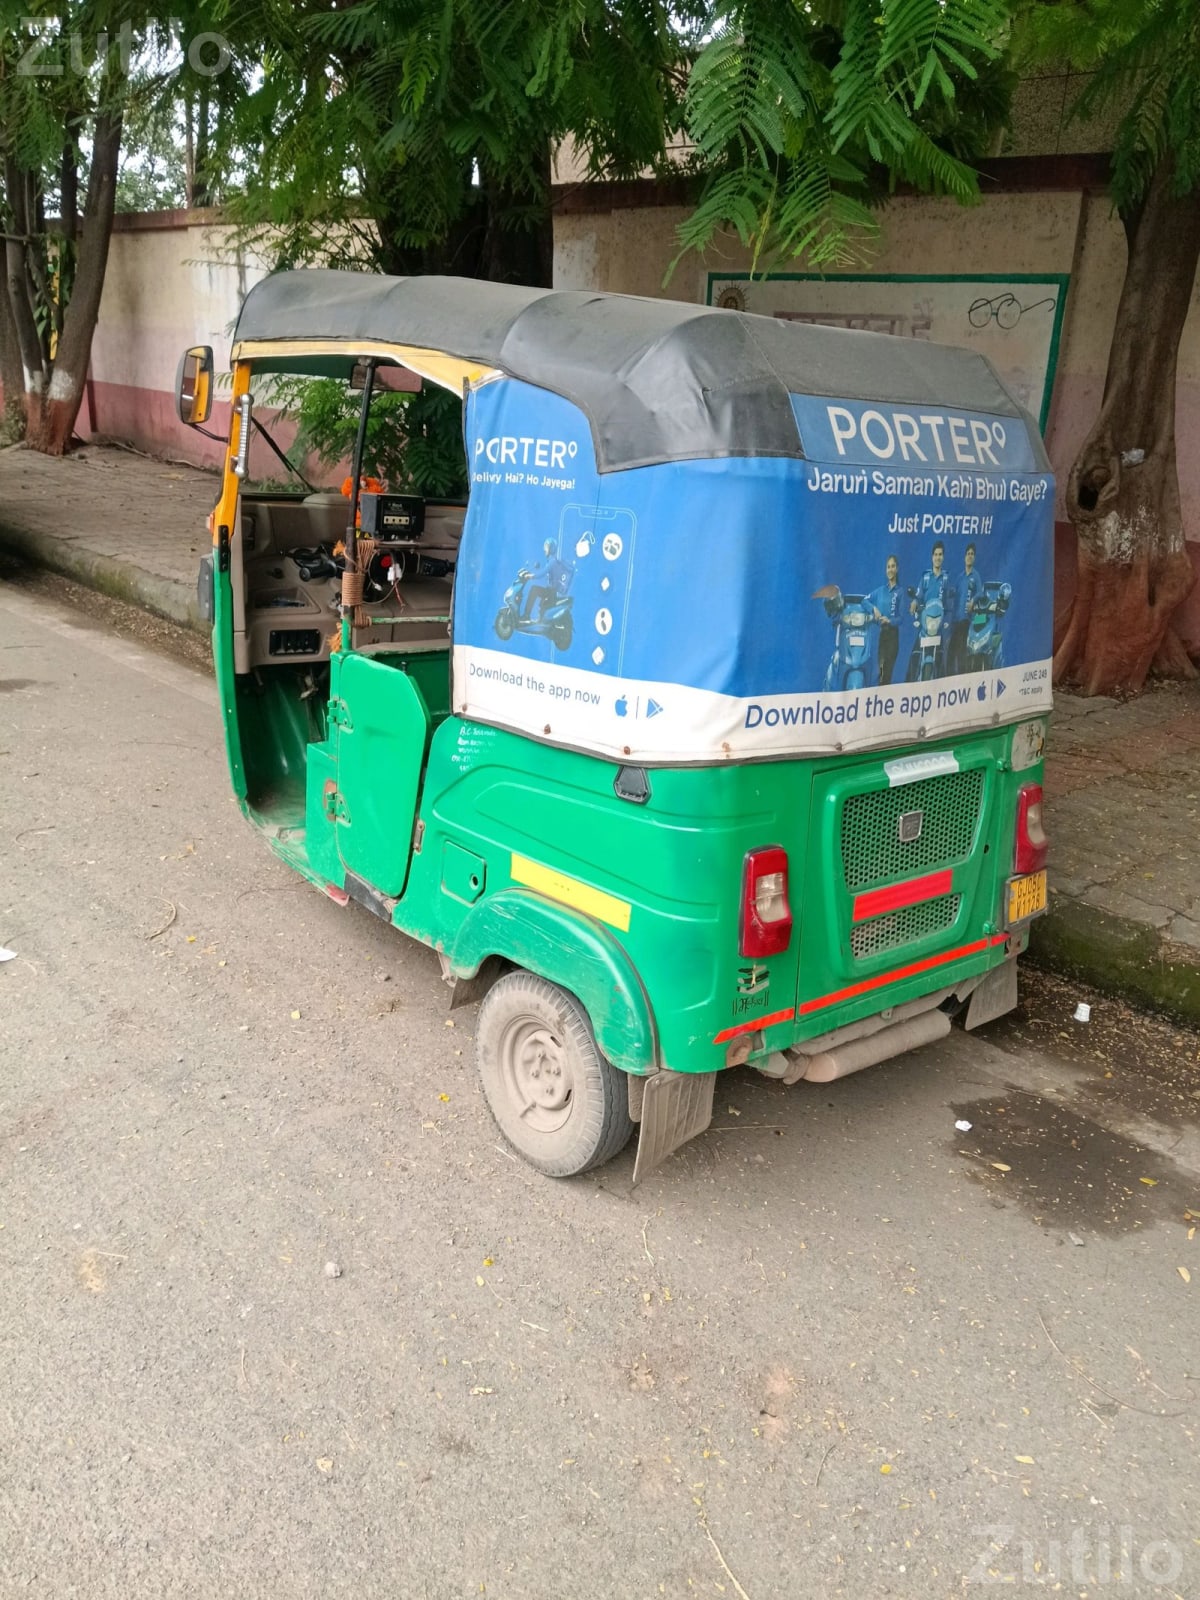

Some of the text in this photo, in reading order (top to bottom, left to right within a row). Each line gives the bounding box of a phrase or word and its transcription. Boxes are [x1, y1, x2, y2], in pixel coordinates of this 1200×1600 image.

[826, 406, 1001, 466] PORTER
[505, 472, 524, 484] Hai?
[526, 474, 539, 485] Ho
[541, 476, 576, 490] Jayega!
[807, 467, 1048, 506] Jaruri Saman Kahi Bhul Gaye?
[888, 513, 993, 535] Just PORTER It!
[469, 663, 601, 705] Download the app now
[1022, 671, 1038, 683] JUNE
[744, 686, 971, 728] Download the app now
